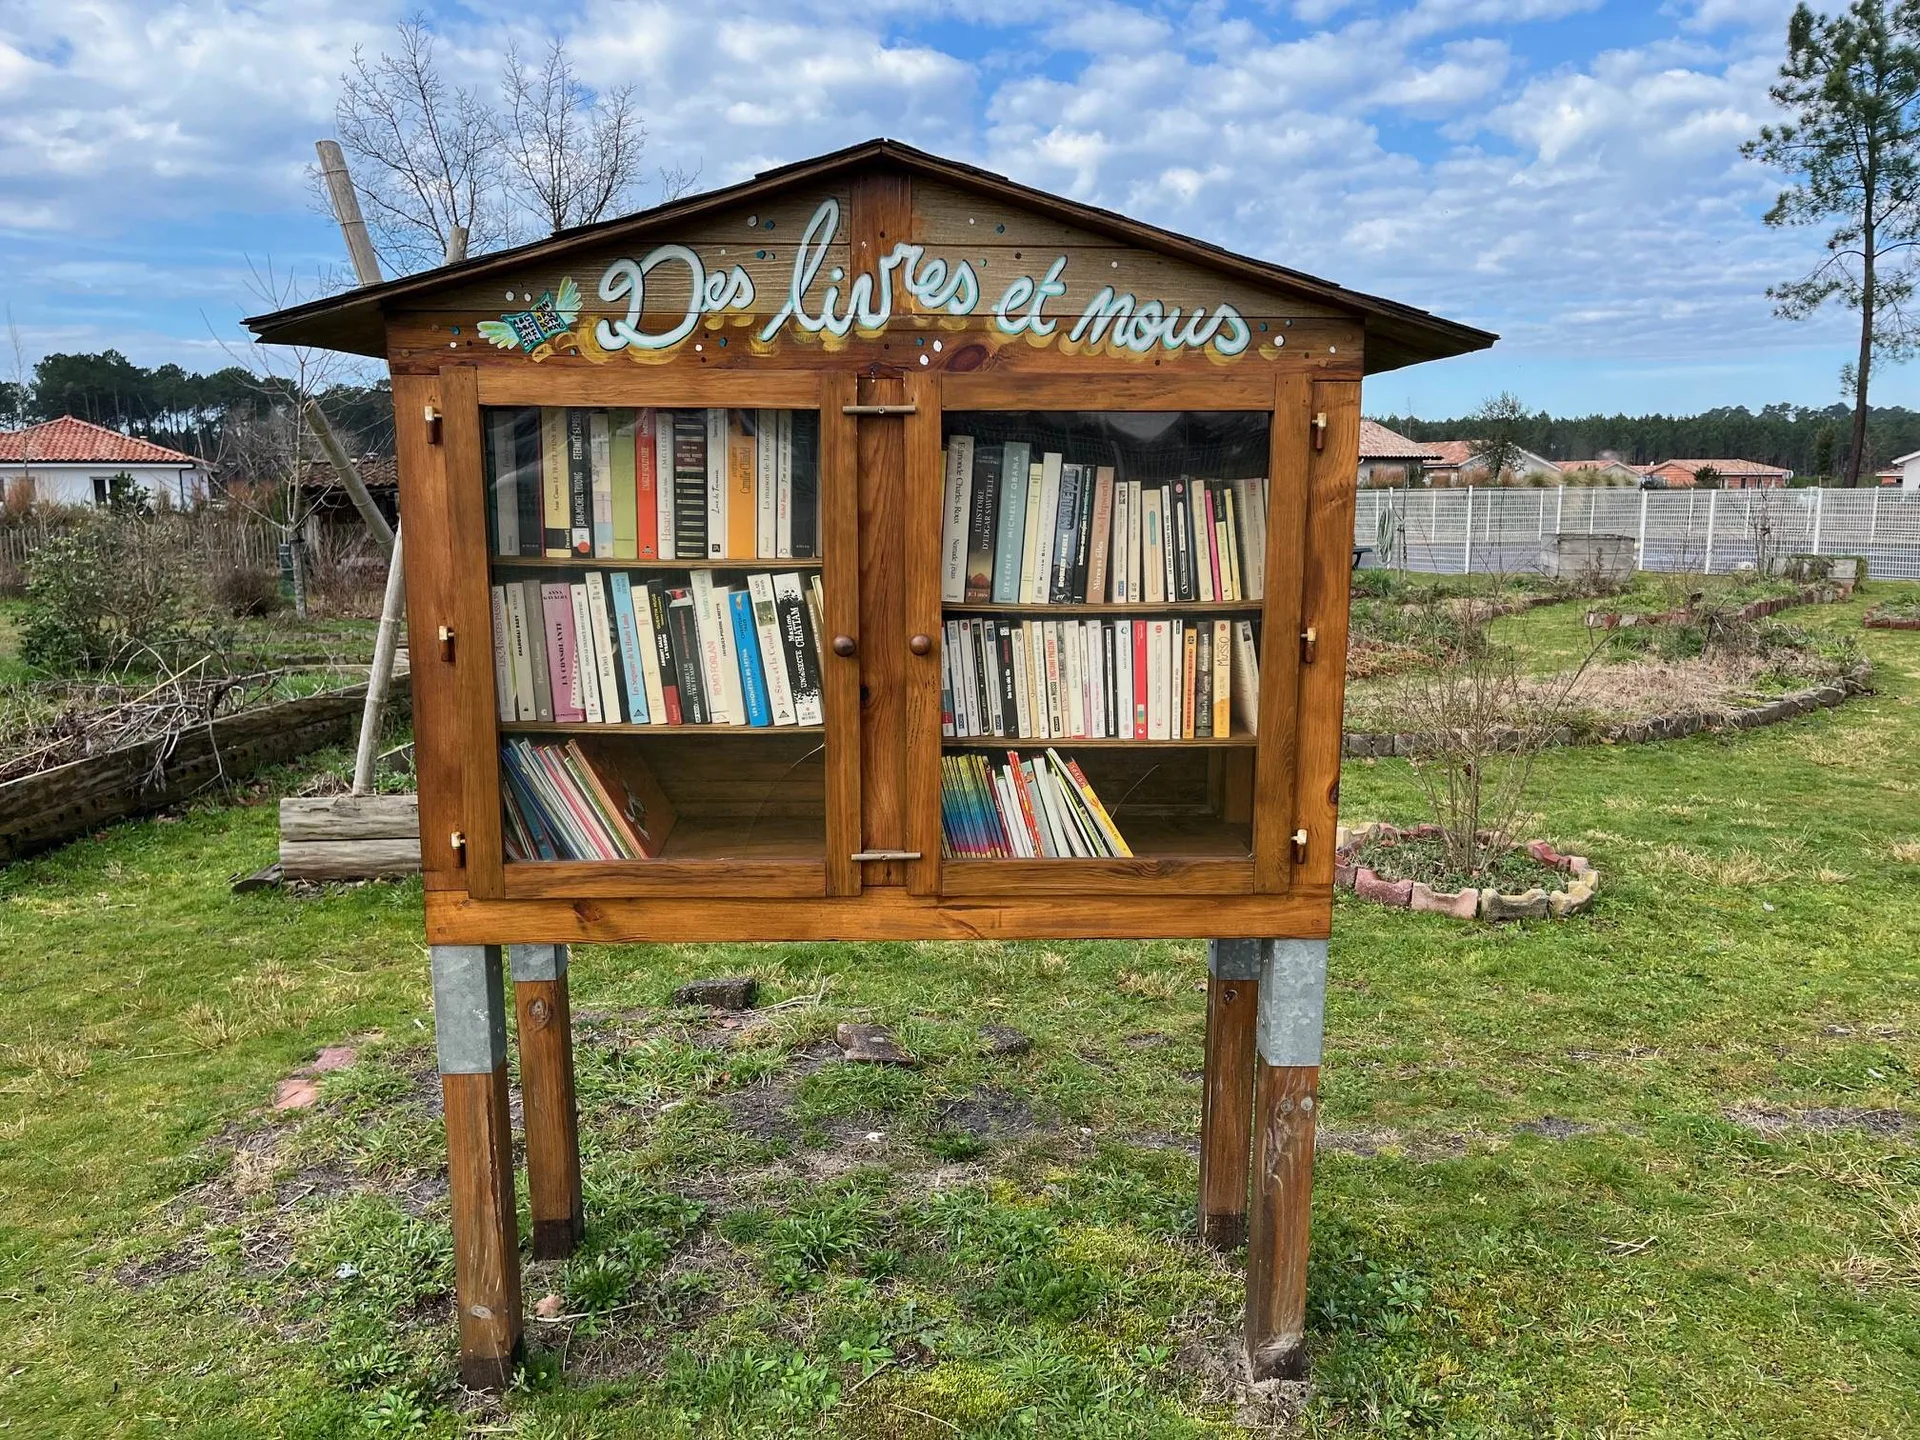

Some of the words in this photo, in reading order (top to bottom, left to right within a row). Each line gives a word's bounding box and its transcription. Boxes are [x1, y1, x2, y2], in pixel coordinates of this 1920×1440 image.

[596, 244, 755, 351] Des
[762, 197, 979, 341] livres
[992, 255, 1068, 335] et
[1071, 285, 1251, 356] nous
[572, 435, 583, 460] ETERNITY
[957, 441, 966, 476] Edmonde
[764, 463, 771, 472] de
[1011, 455, 1020, 490] OBAMA
[764, 500, 771, 510] La
[986, 472, 995, 514] SAWTELLE
[1059, 468, 1079, 530] MALEVIL
[1099, 479, 1109, 520] Hepworth
[576, 494, 587, 527] JEAN-MICHEL
[661, 511, 672, 542] Hasard
[975, 489, 983, 533] L'HISTOIRE
[1007, 493, 1017, 538] MICHELLE
[983, 515, 992, 550] D'EDGAR
[1060, 532, 1069, 557] MERLE
[1004, 553, 1012, 593] DEVENIR
[1058, 558, 1067, 588] ROBERT
[765, 627, 776, 656] Cendre
[786, 614, 795, 642] Maxime
[791, 606, 805, 648] CHATTAM
[557, 621, 567, 673] CONSOLANTE
[769, 656, 778, 665] la
[1202, 633, 1210, 672] Maupassant
[561, 675, 568, 686] LA
[771, 666, 780, 674] et
[632, 686, 640, 696] Les
[777, 696, 785, 706] La
